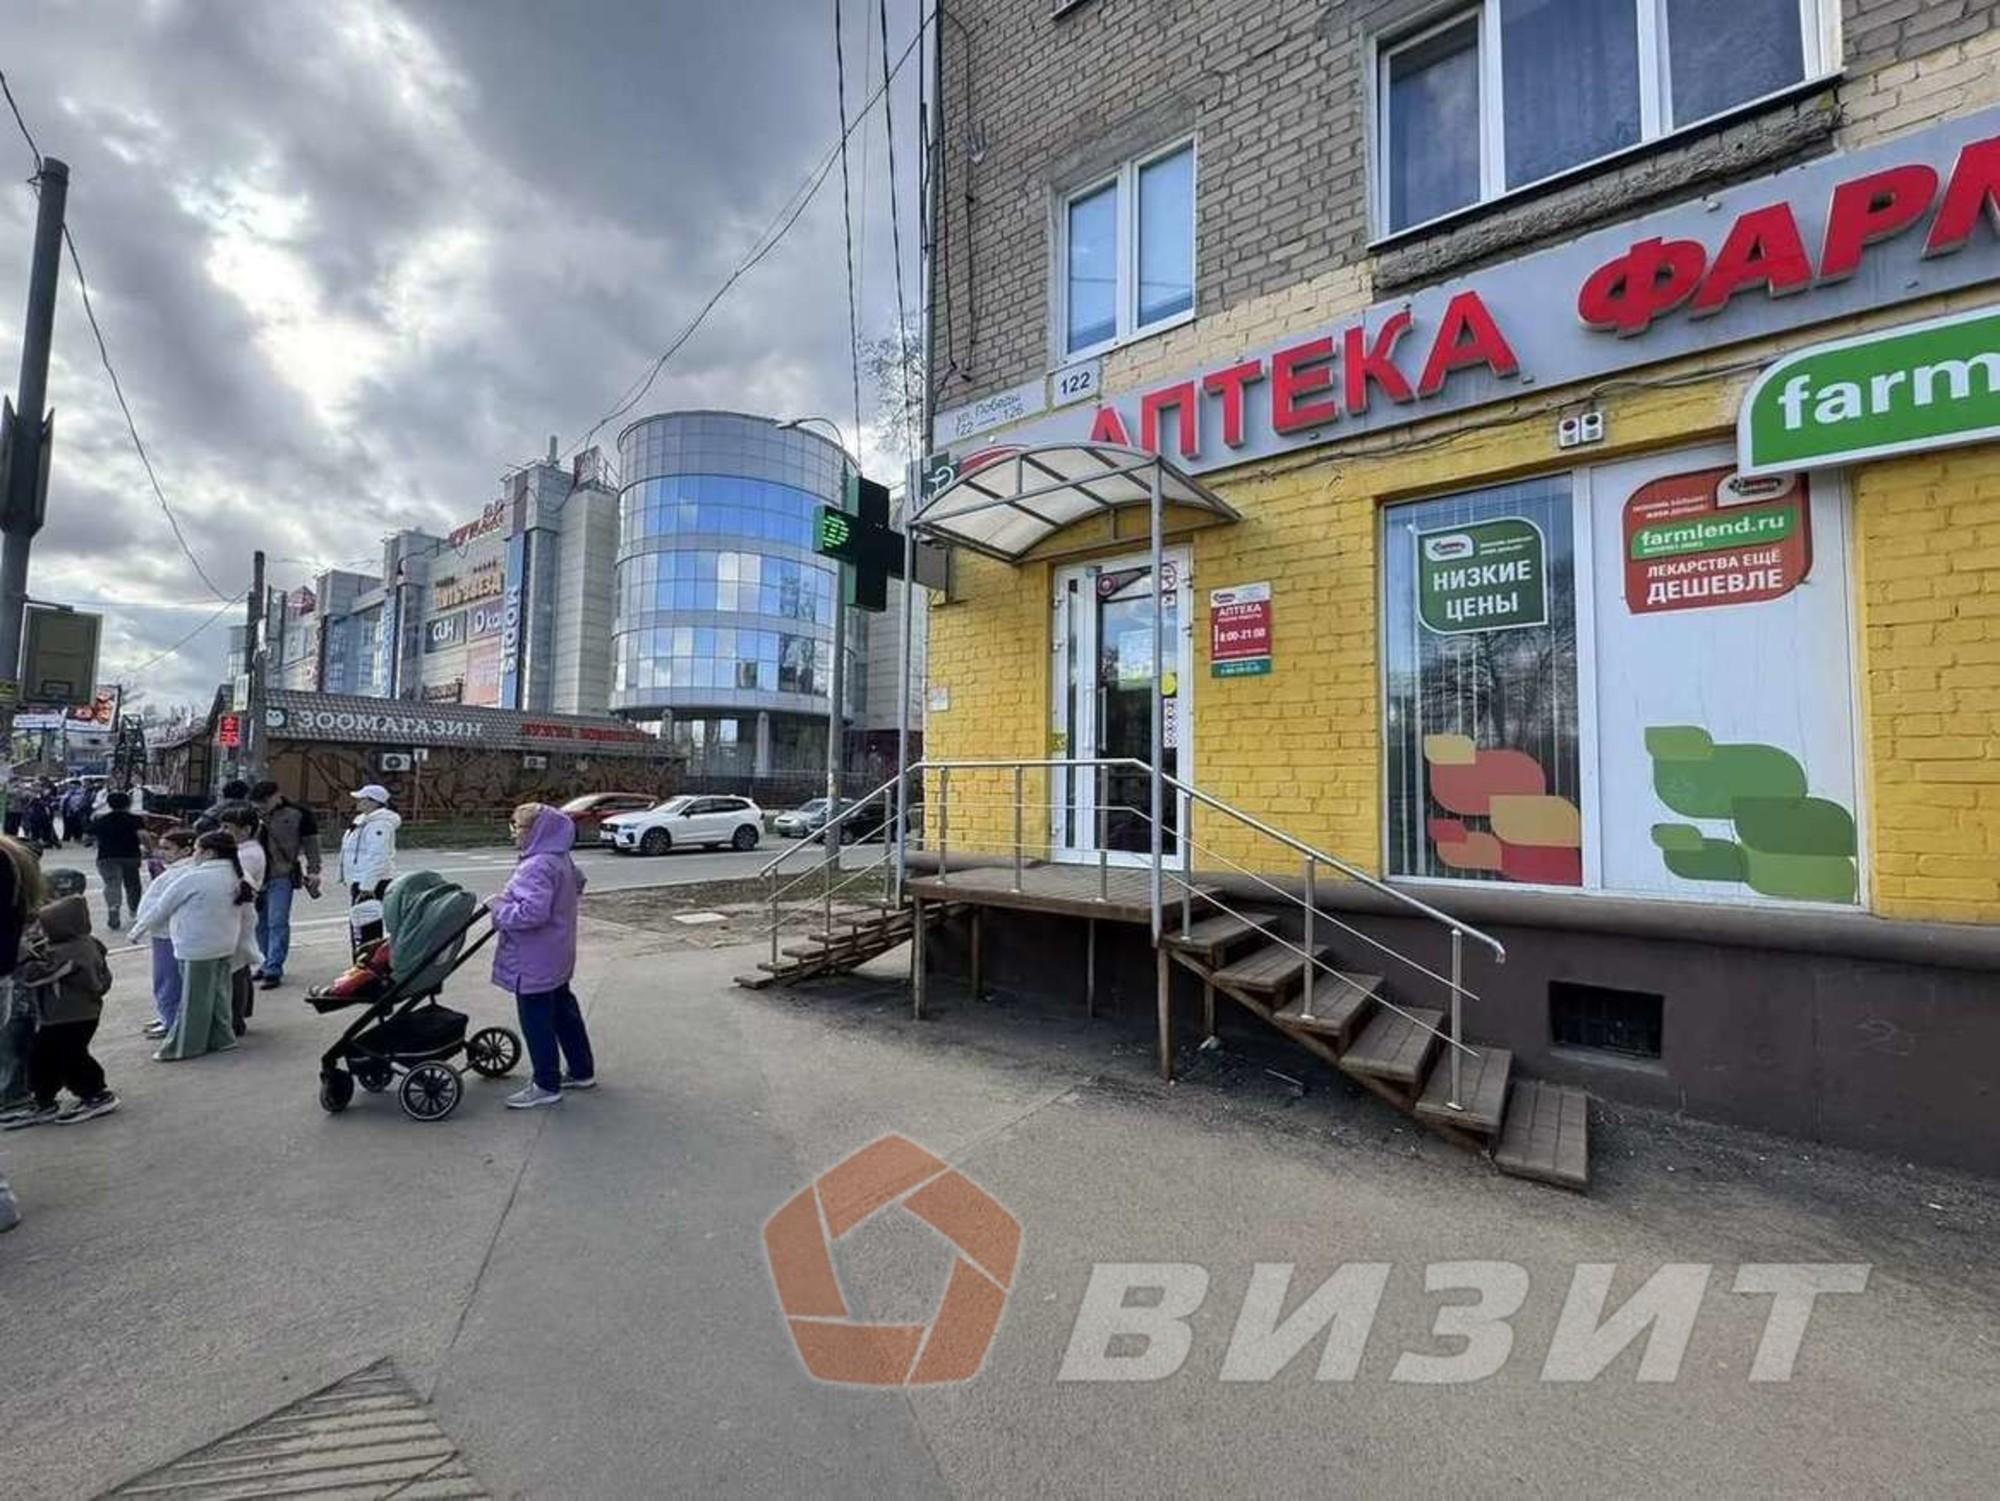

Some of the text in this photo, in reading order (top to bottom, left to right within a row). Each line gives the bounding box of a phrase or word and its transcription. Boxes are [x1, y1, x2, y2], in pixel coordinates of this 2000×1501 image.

[1060, 371, 1091, 395] 122
[1641, 514, 1785, 547] farmlend.ru
[1433, 559, 1532, 592] НИЗКИЕ
[1647, 555, 1739, 578] ЛЕКАРСТВА
[1646, 568, 1784, 605] ДЕШЕВЛЕ
[1219, 603, 1262, 617] АПТЕКА
[1446, 591, 1518, 623] ЦЕНЫ
[298, 709, 484, 738] ЗООМАГАЗИН
